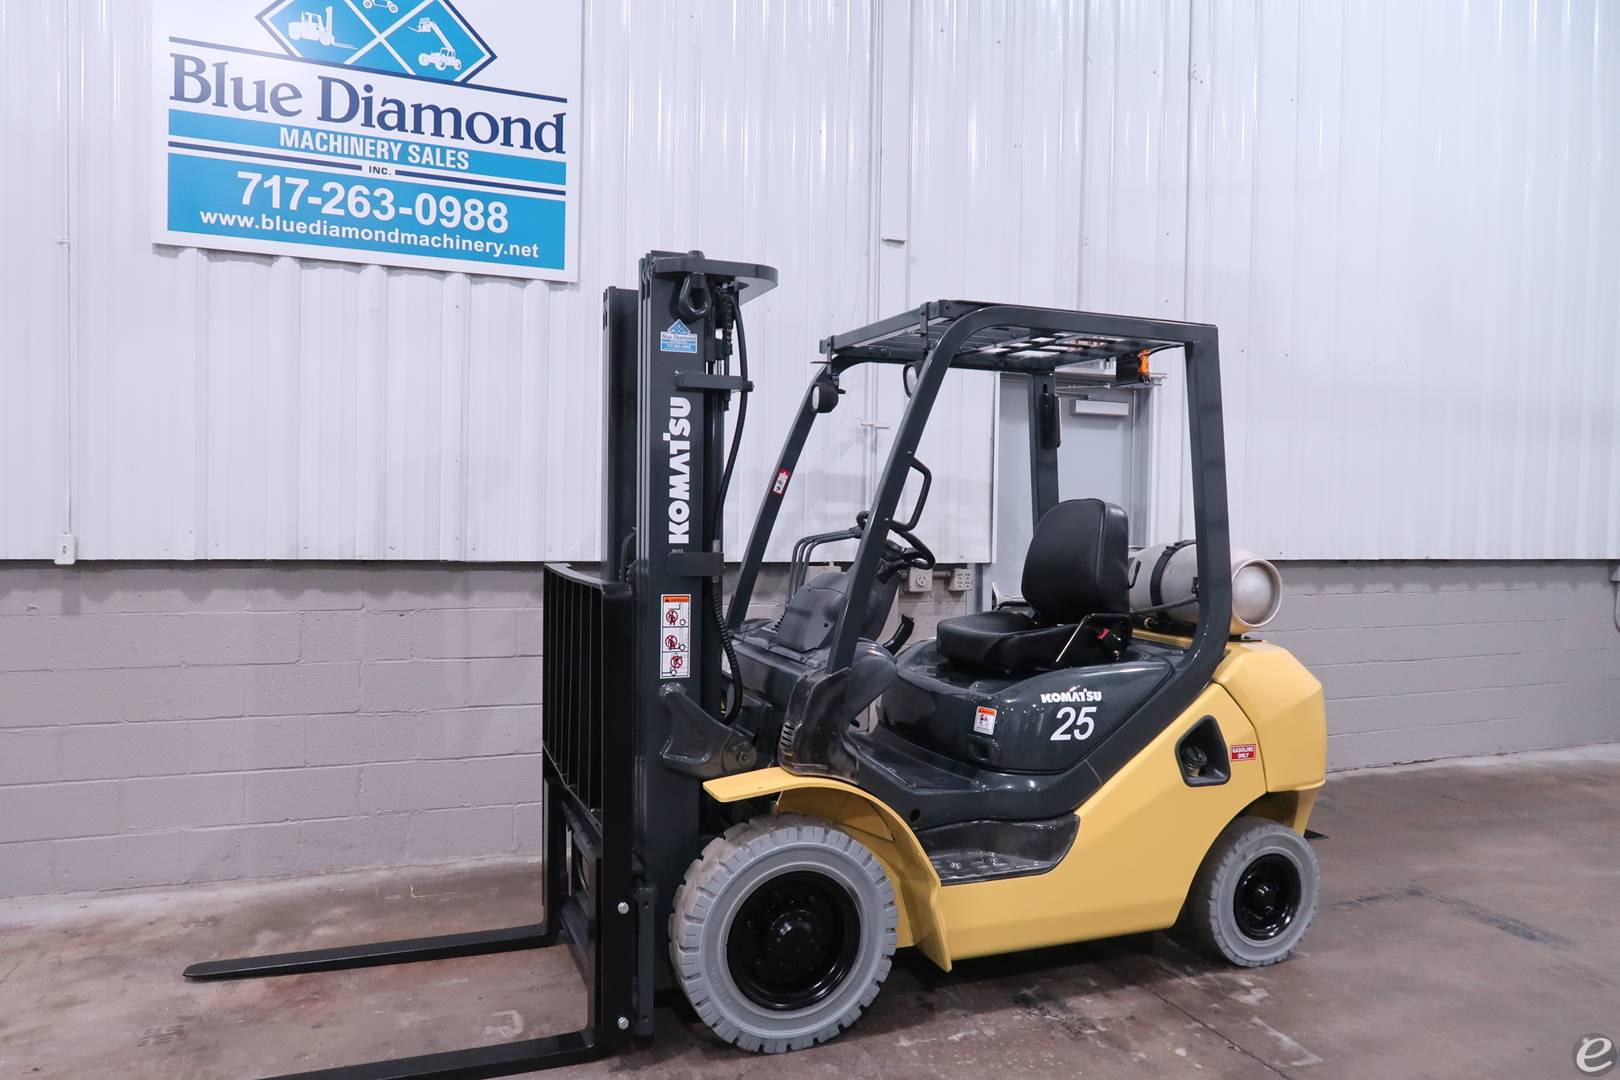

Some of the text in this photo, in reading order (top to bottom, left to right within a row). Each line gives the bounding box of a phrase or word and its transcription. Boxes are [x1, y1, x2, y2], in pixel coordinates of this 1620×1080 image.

[169, 53, 567, 154] Blue Diamond
[279, 127, 470, 170] MACHINERY SALES
[368, 165, 392, 176] INC.
[237, 171, 509, 234] 717-263-0988
[200, 210, 540, 258] www.bluediamondmachinery.net
[663, 397, 691, 544] KOMATSU
[1040, 688, 1102, 704] KOMATSU
[1050, 706, 1097, 741] 25
